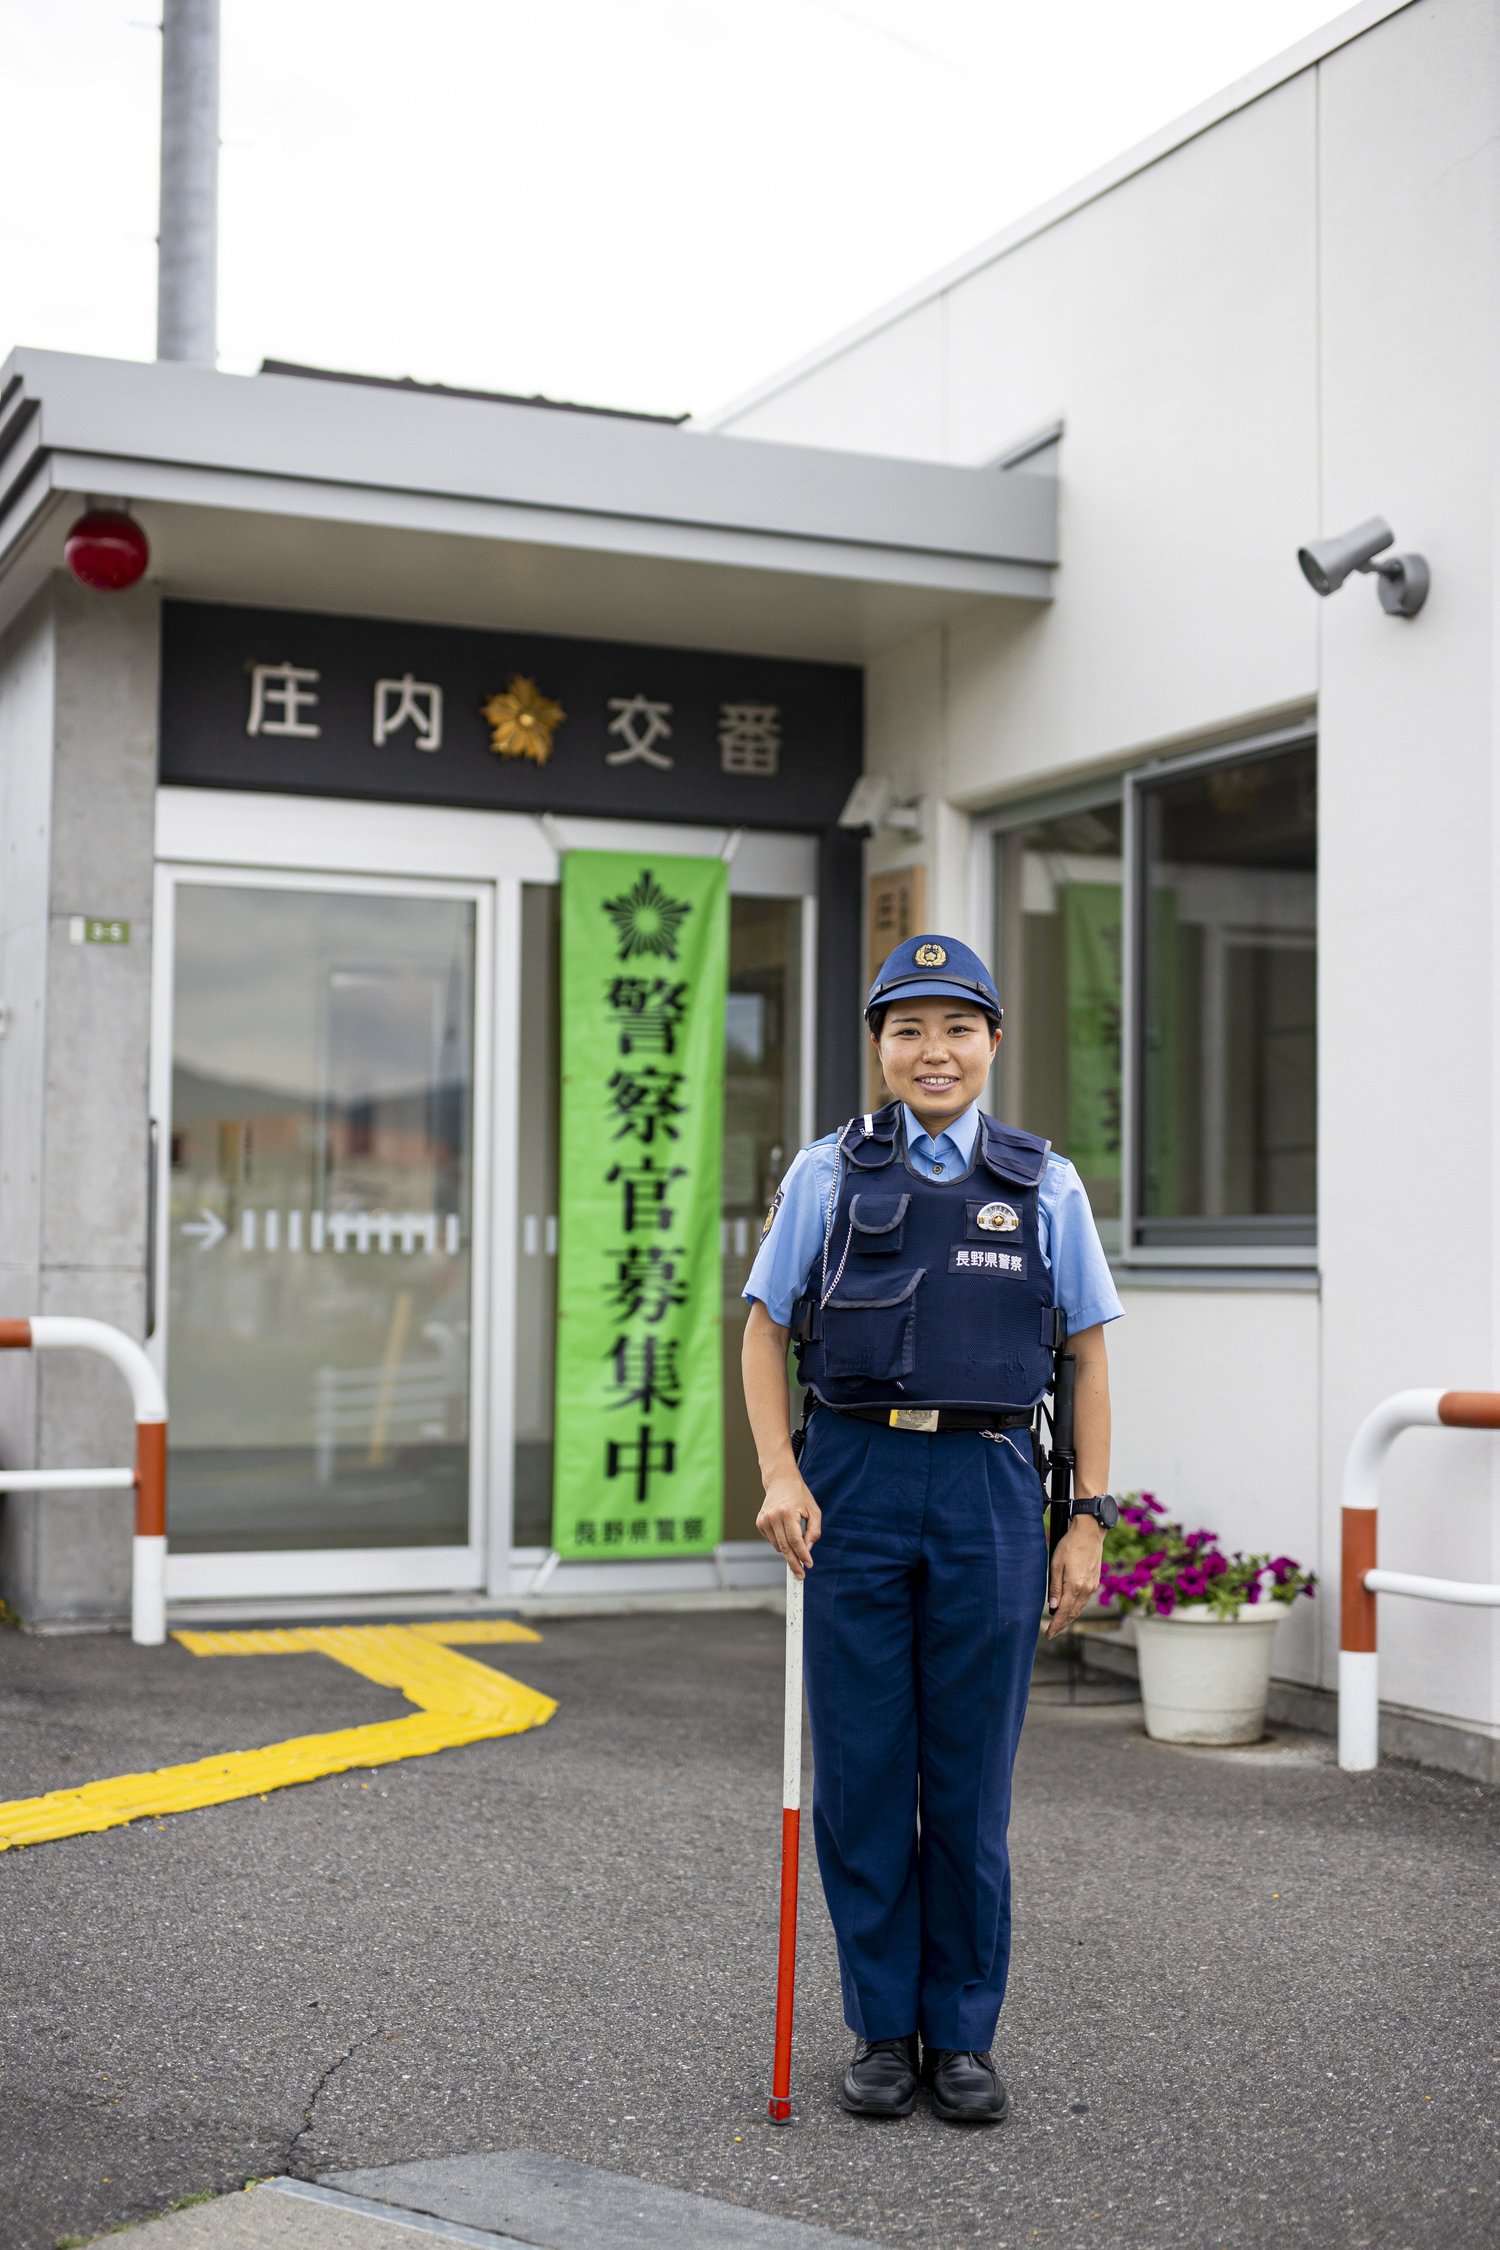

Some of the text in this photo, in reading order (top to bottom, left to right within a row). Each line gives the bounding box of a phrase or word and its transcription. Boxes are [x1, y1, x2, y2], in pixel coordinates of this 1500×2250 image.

[246, 662, 784, 776] 庄内 交番
[604, 975, 690, 1503] 警察官募集中
[956, 1251, 1022, 1272] 長野県警察
